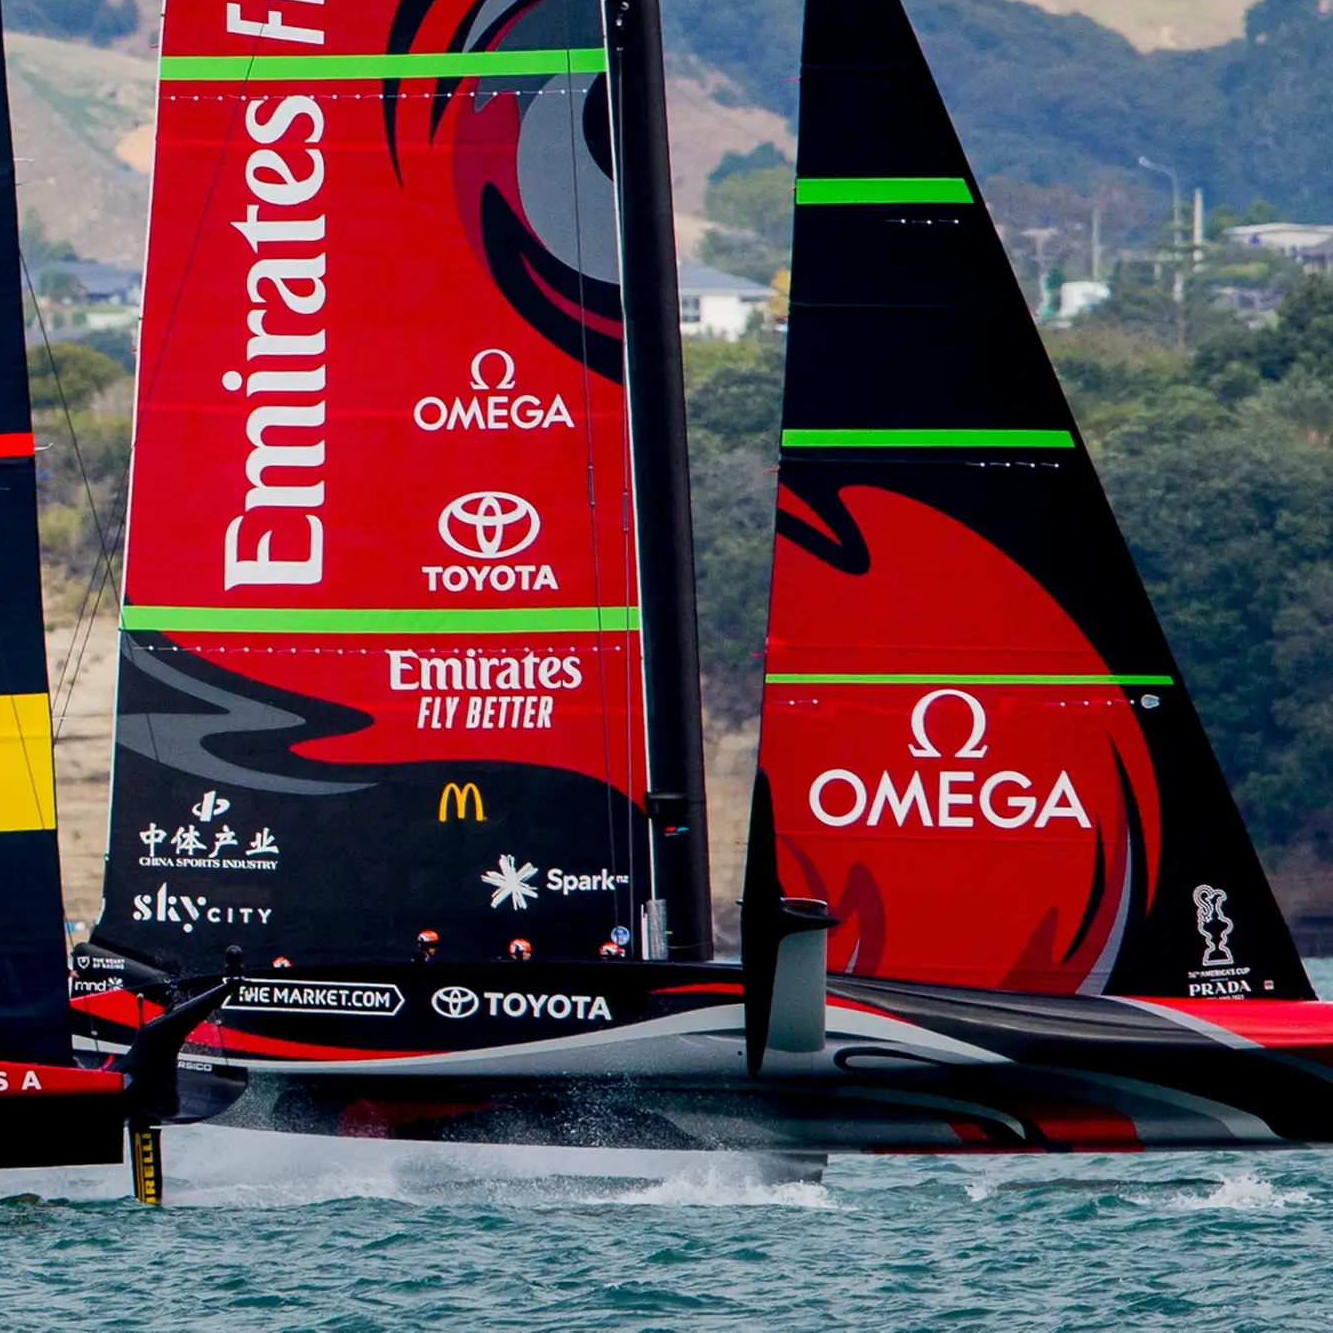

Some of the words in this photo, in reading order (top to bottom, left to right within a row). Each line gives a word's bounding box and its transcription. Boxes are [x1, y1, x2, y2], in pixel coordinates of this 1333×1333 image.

[219, 95, 326, 591] Emirates
[413, 394, 575, 431] OMEGA
[421, 564, 559, 592] TOYOTA
[385, 648, 583, 691] Emirates
[417, 696, 460, 729] FLY
[465, 695, 554, 729] BETTER
[809, 768, 1092, 829] OMEGA
[139, 822, 279, 858] 中体产业
[139, 857, 174, 867] CHINA
[176, 858, 220, 869] SPORTS
[222, 860, 278, 870] INDUSTRY
[74, 979, 107, 992] mnd
[272, 986, 391, 1008] MARKET.COM
[1188, 979, 1252, 997] PRADA
[483, 991, 612, 1021] TOYOTA
